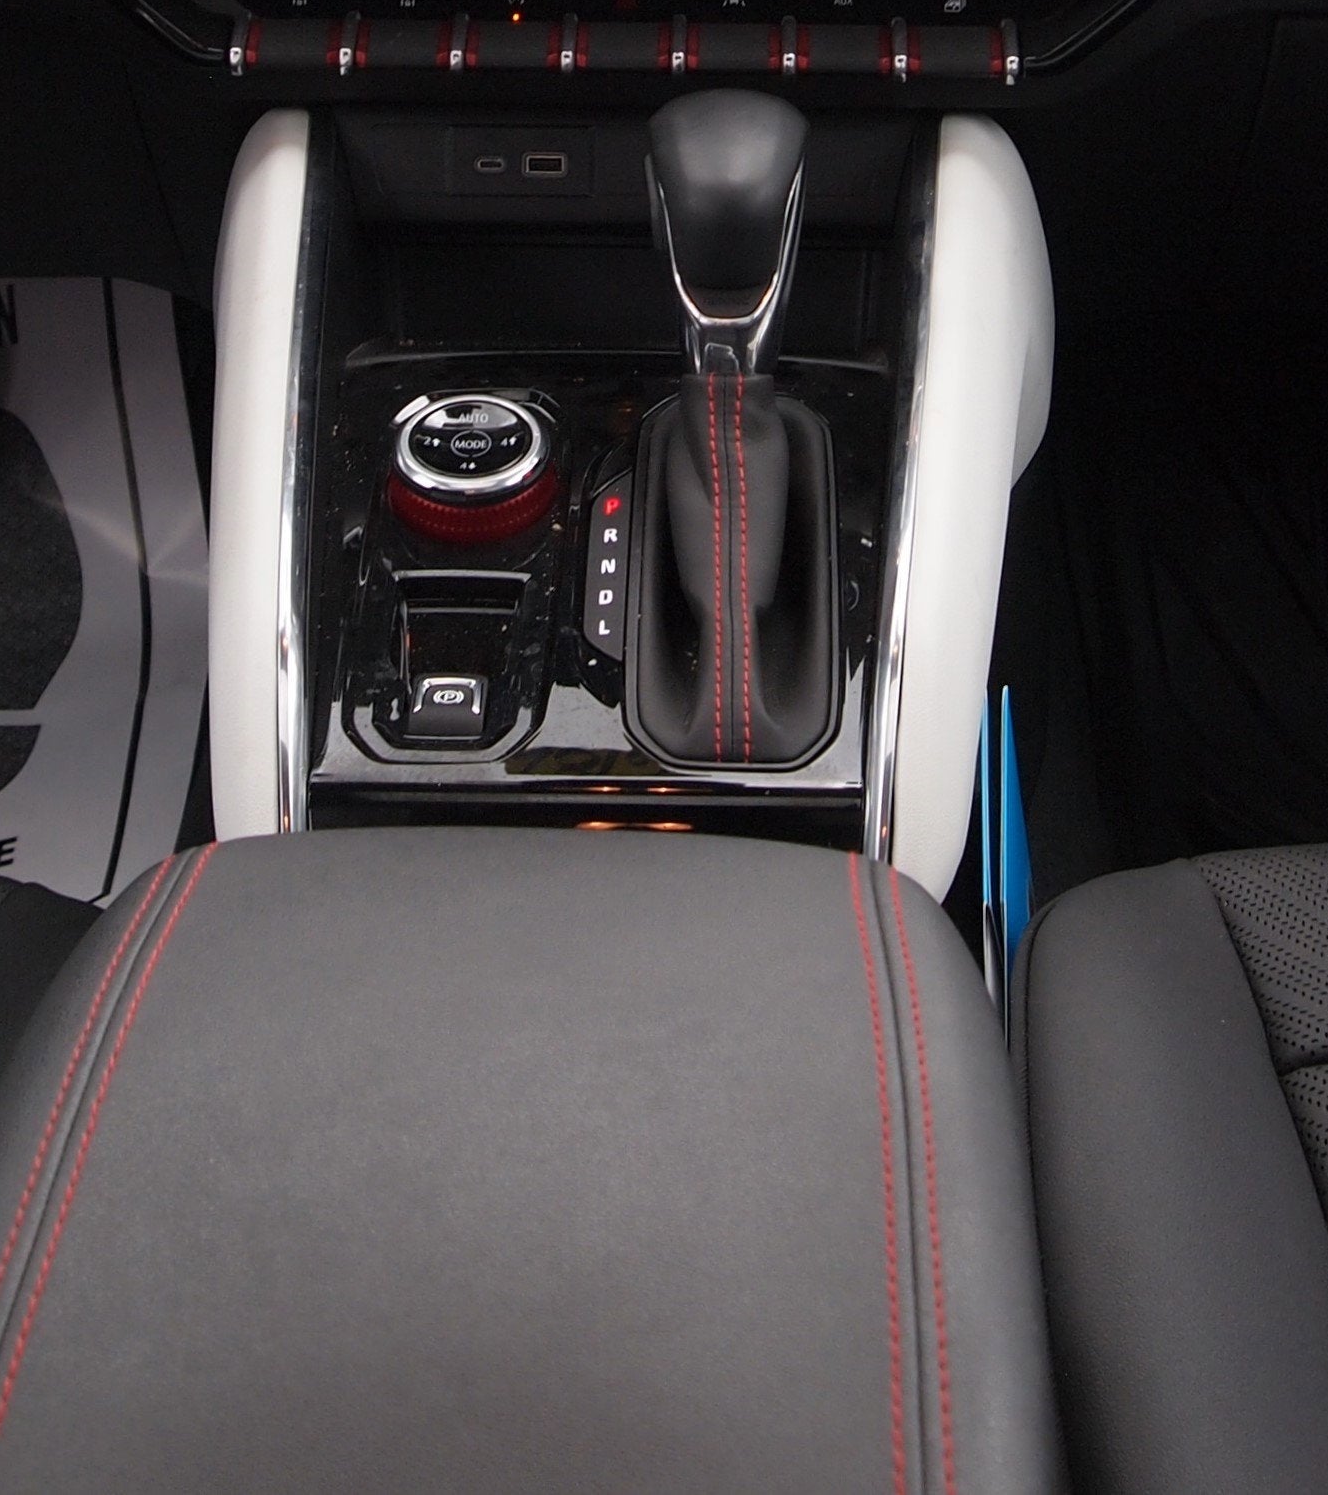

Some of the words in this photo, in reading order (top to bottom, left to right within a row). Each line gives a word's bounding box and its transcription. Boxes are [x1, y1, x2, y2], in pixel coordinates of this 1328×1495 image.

[458, 412, 490, 424] AUTO
[454, 439, 488, 450] MODE
[604, 497, 621, 516] P
[603, 527, 618, 544] R
[600, 558, 617, 575] N
[598, 589, 614, 606] D
[598, 619, 611, 636] L
